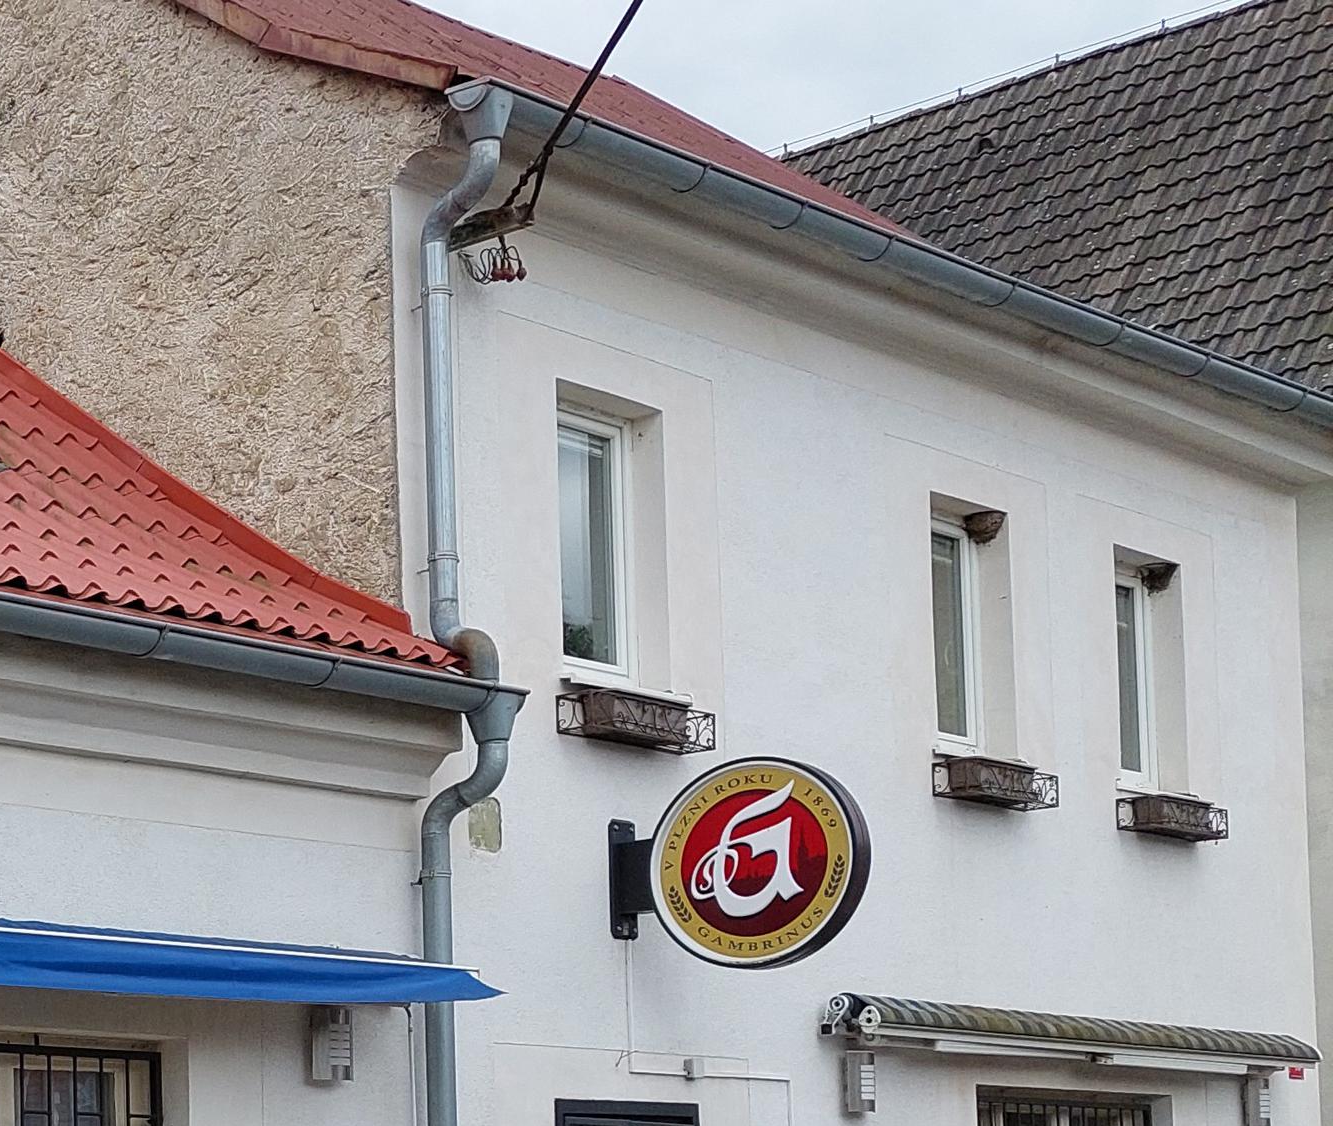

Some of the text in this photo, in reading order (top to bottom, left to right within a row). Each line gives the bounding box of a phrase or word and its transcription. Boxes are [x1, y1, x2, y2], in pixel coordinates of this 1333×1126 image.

[664, 774, 838, 871] V PLZNI ROKU 1869
[697, 906, 824, 952] GAMBRINUS
